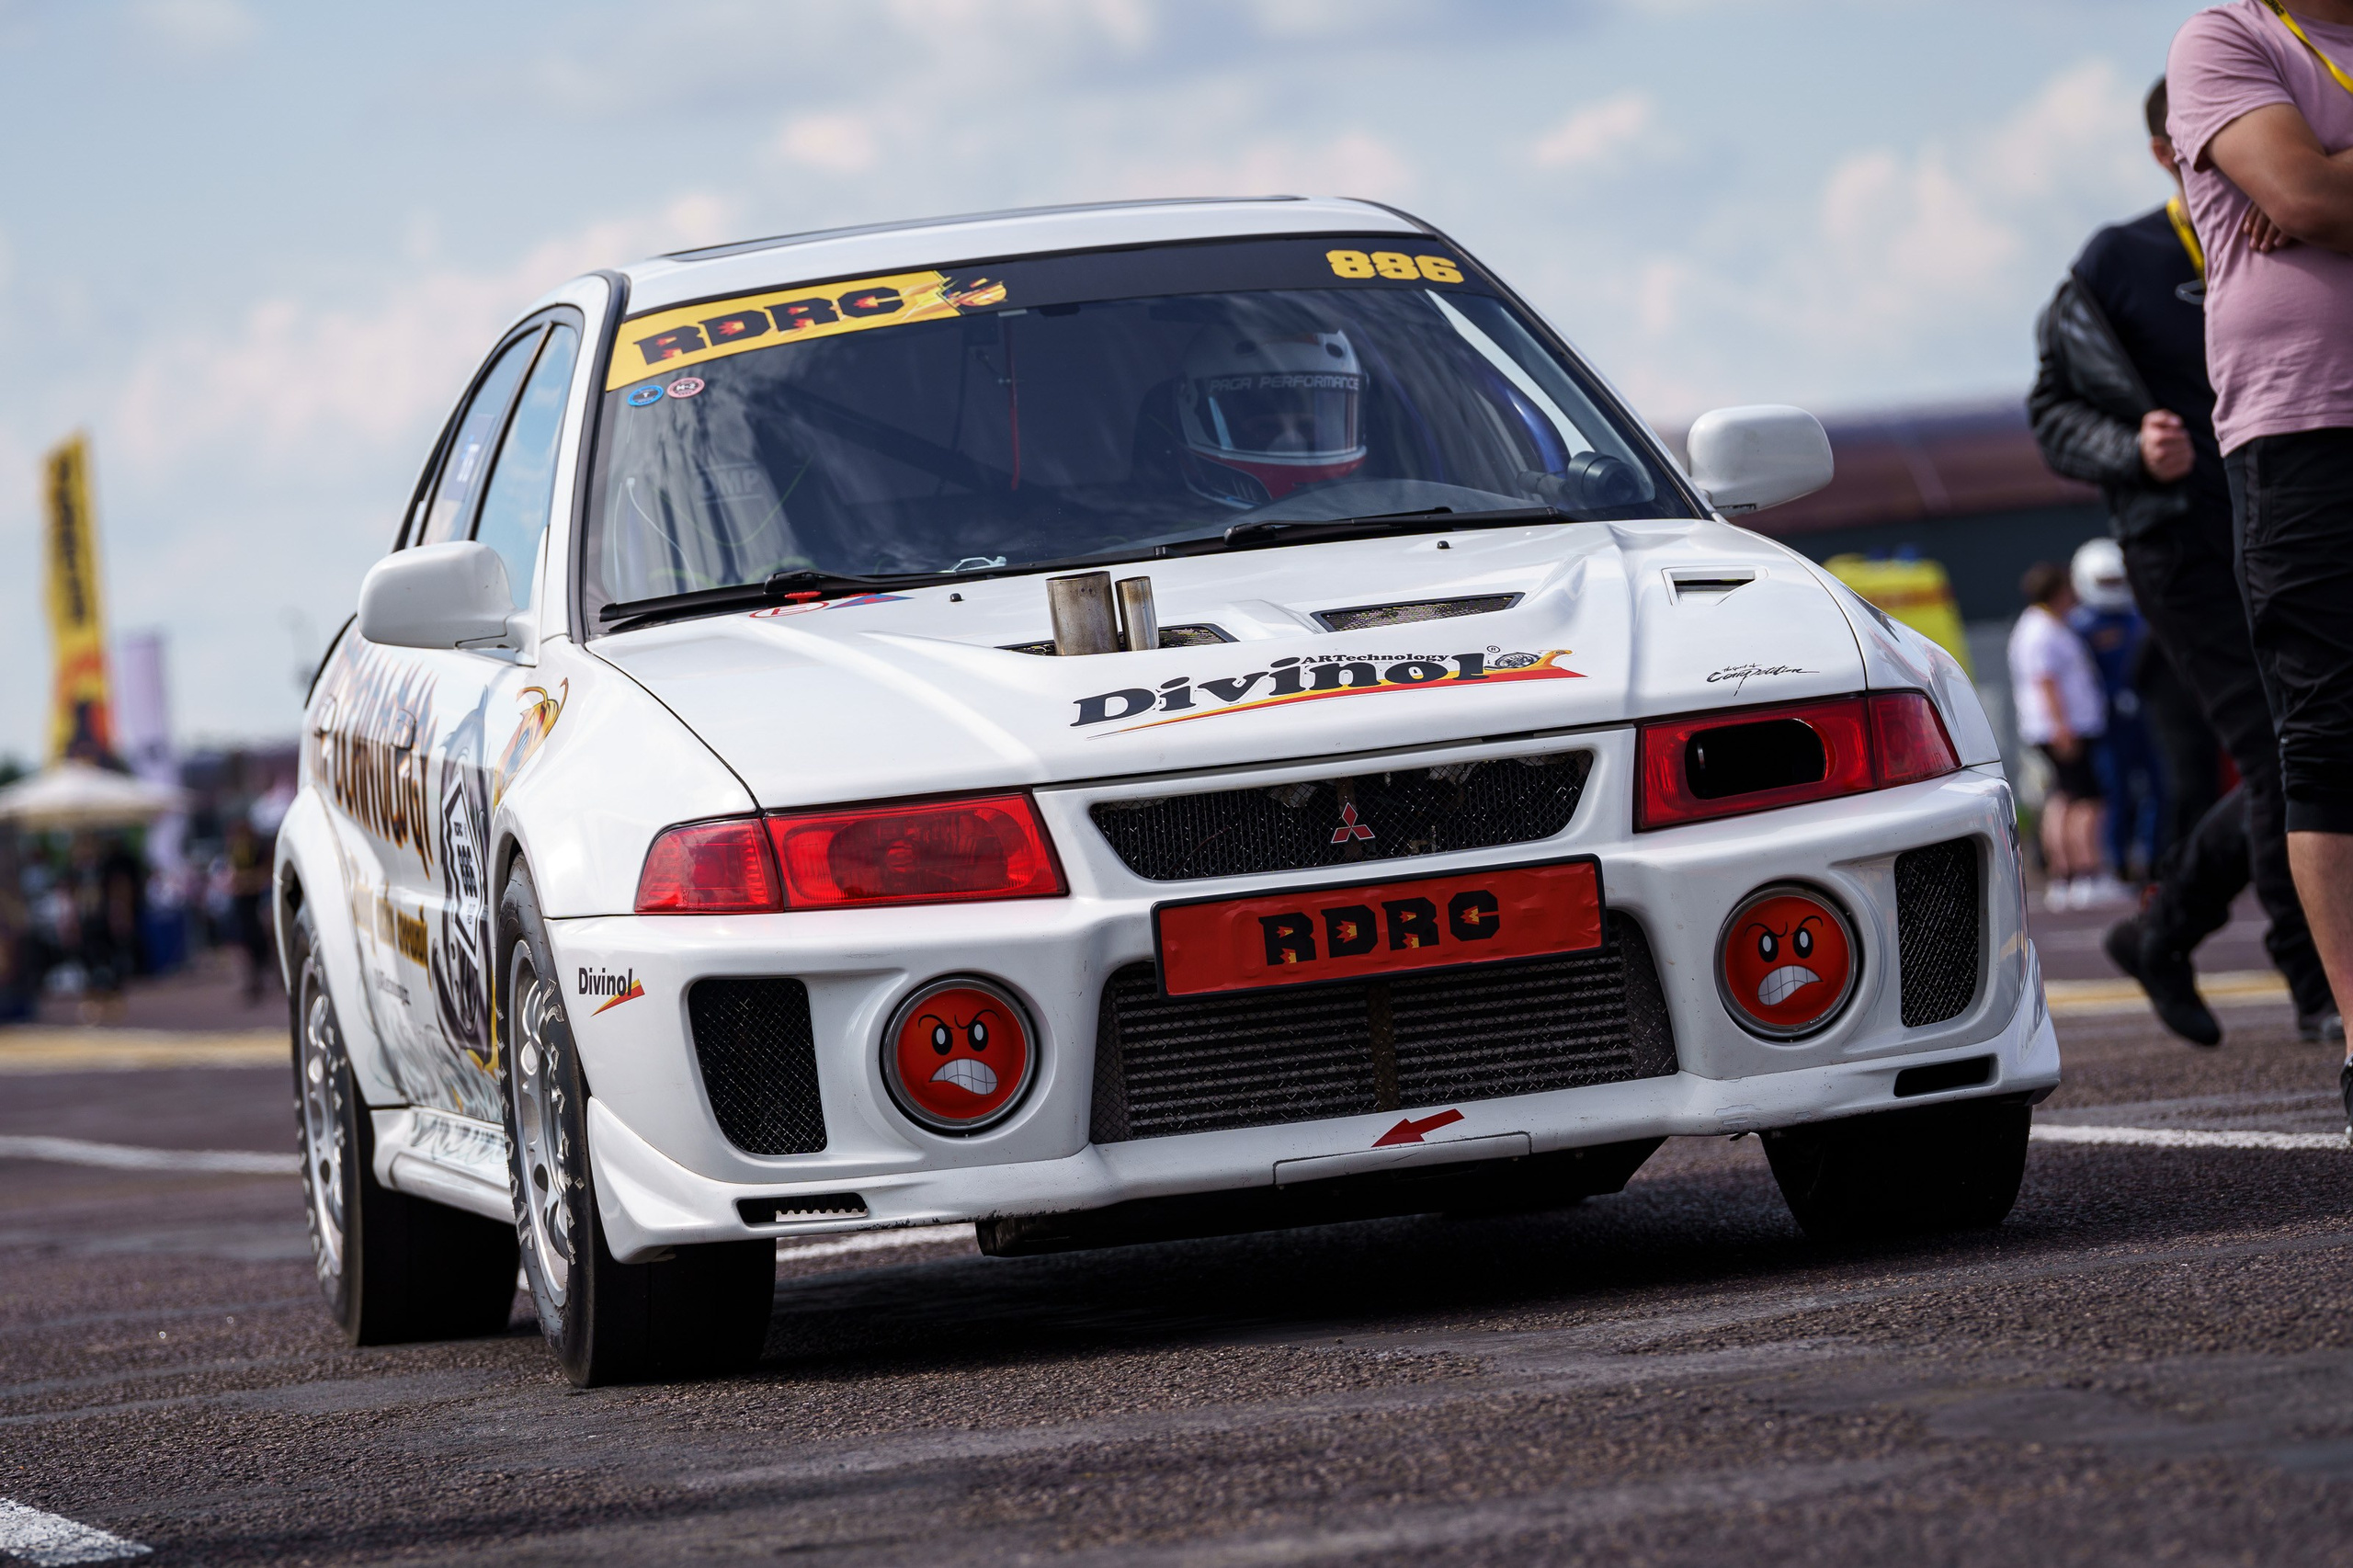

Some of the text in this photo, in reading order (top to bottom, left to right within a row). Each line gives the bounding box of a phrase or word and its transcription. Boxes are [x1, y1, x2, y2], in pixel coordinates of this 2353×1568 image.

[1325, 249, 1464, 284] 886
[632, 286, 904, 365] RDRC
[1258, 374, 1360, 392] PERFORMANCE
[1302, 653, 1449, 664] ARTechnology
[1070, 653, 1489, 726] Divinol
[1258, 889, 1500, 967] RDRC
[578, 967, 632, 996] Divinol
